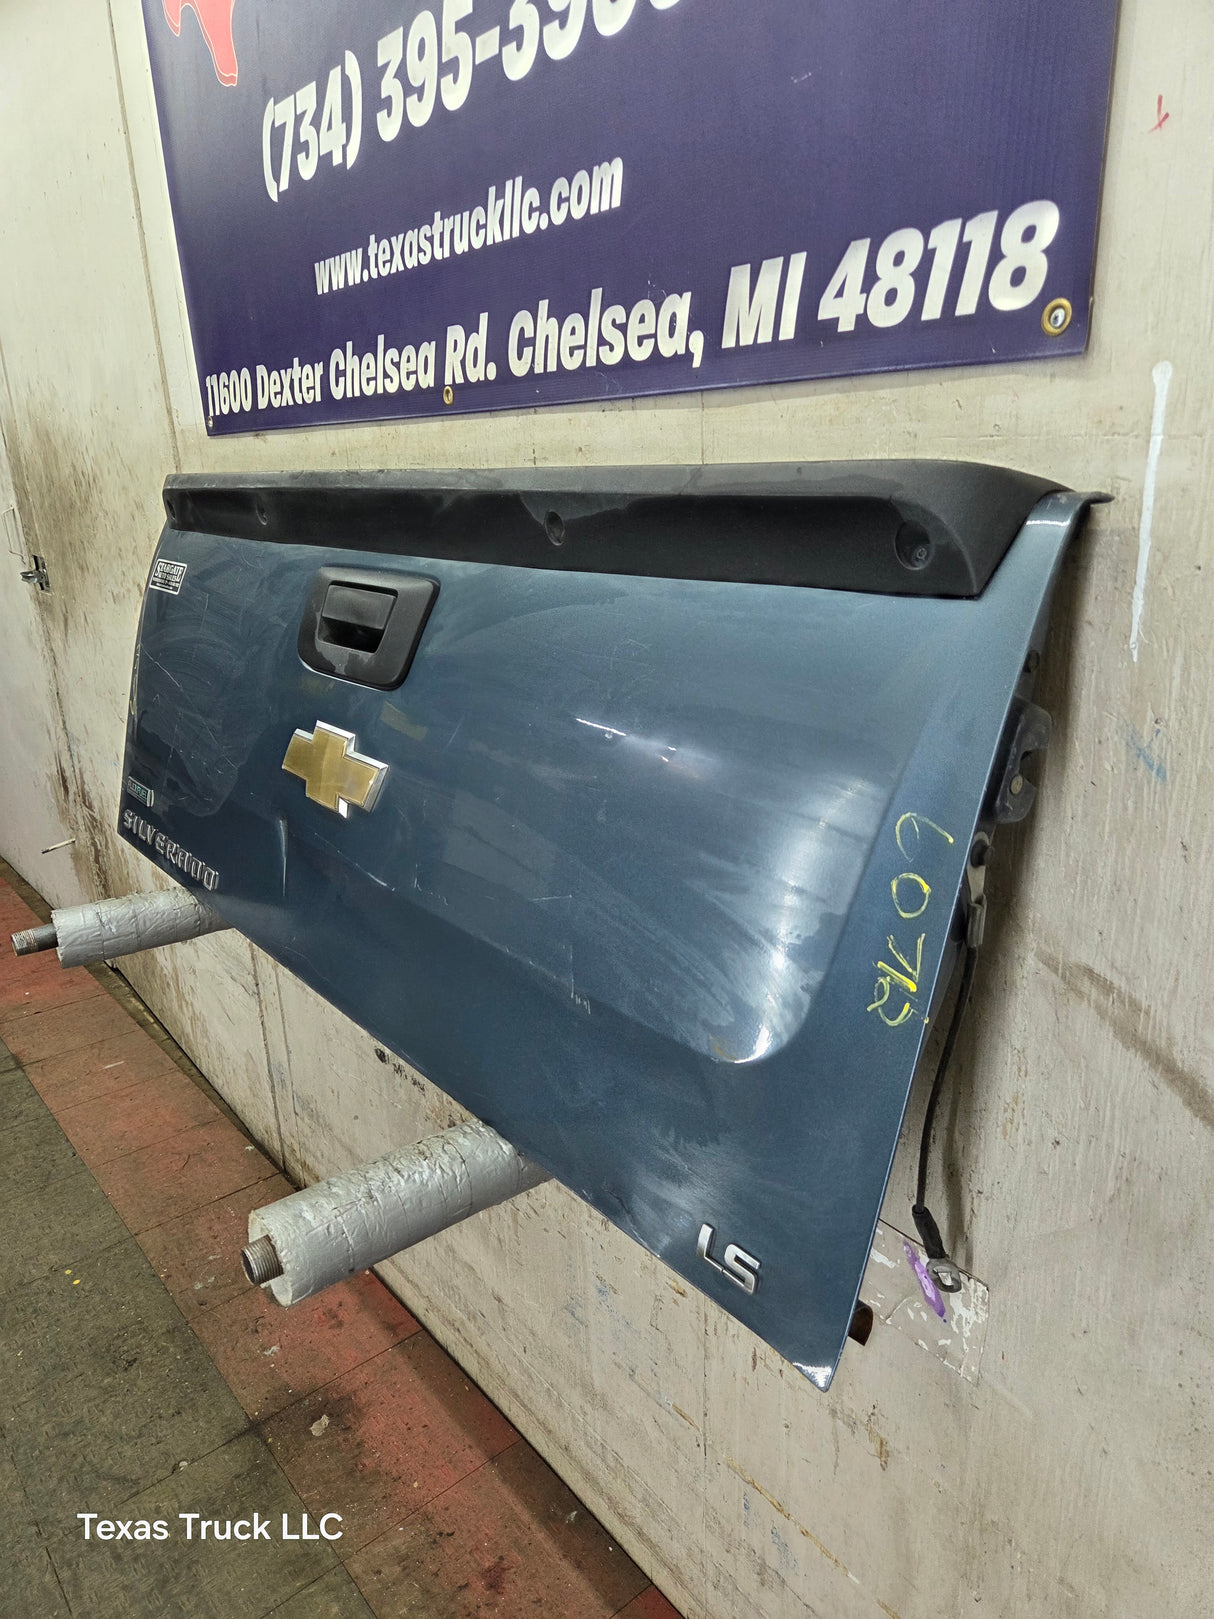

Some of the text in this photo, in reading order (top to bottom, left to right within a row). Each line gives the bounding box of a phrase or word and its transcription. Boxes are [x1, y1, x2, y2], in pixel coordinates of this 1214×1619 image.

[263, 50, 362, 202] (734)
[314, 157, 624, 295] www.texastruckllc.com
[205, 200, 1060, 416] 11600 Dexter Chelsea Rd. Chelsea, MI 48118
[123, 808, 219, 891] SILVERADO
[697, 1223, 761, 1295] LS
